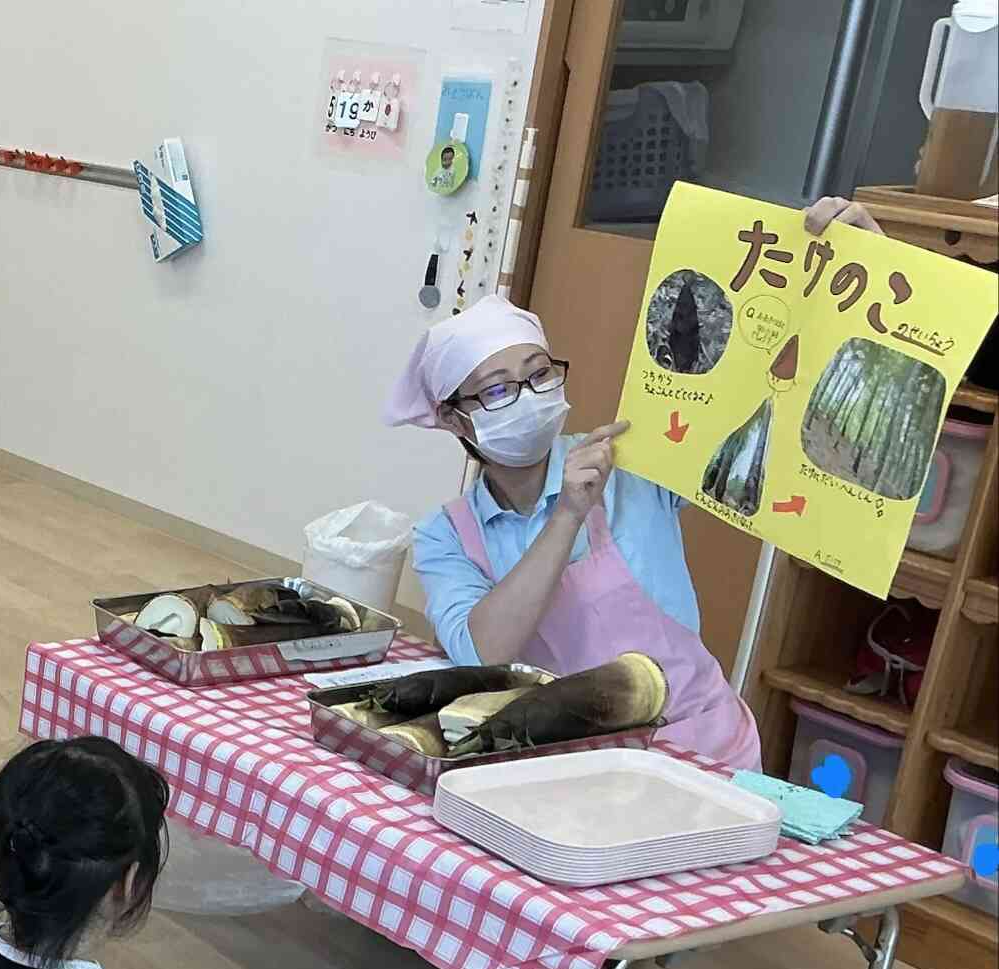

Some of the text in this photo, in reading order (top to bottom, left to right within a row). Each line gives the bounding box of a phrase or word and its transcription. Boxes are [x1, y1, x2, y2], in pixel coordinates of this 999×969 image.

[327, 95, 374, 120] 5 19 か
[359, 128, 377, 140] ようび
[729, 220, 913, 335] たけのこ
